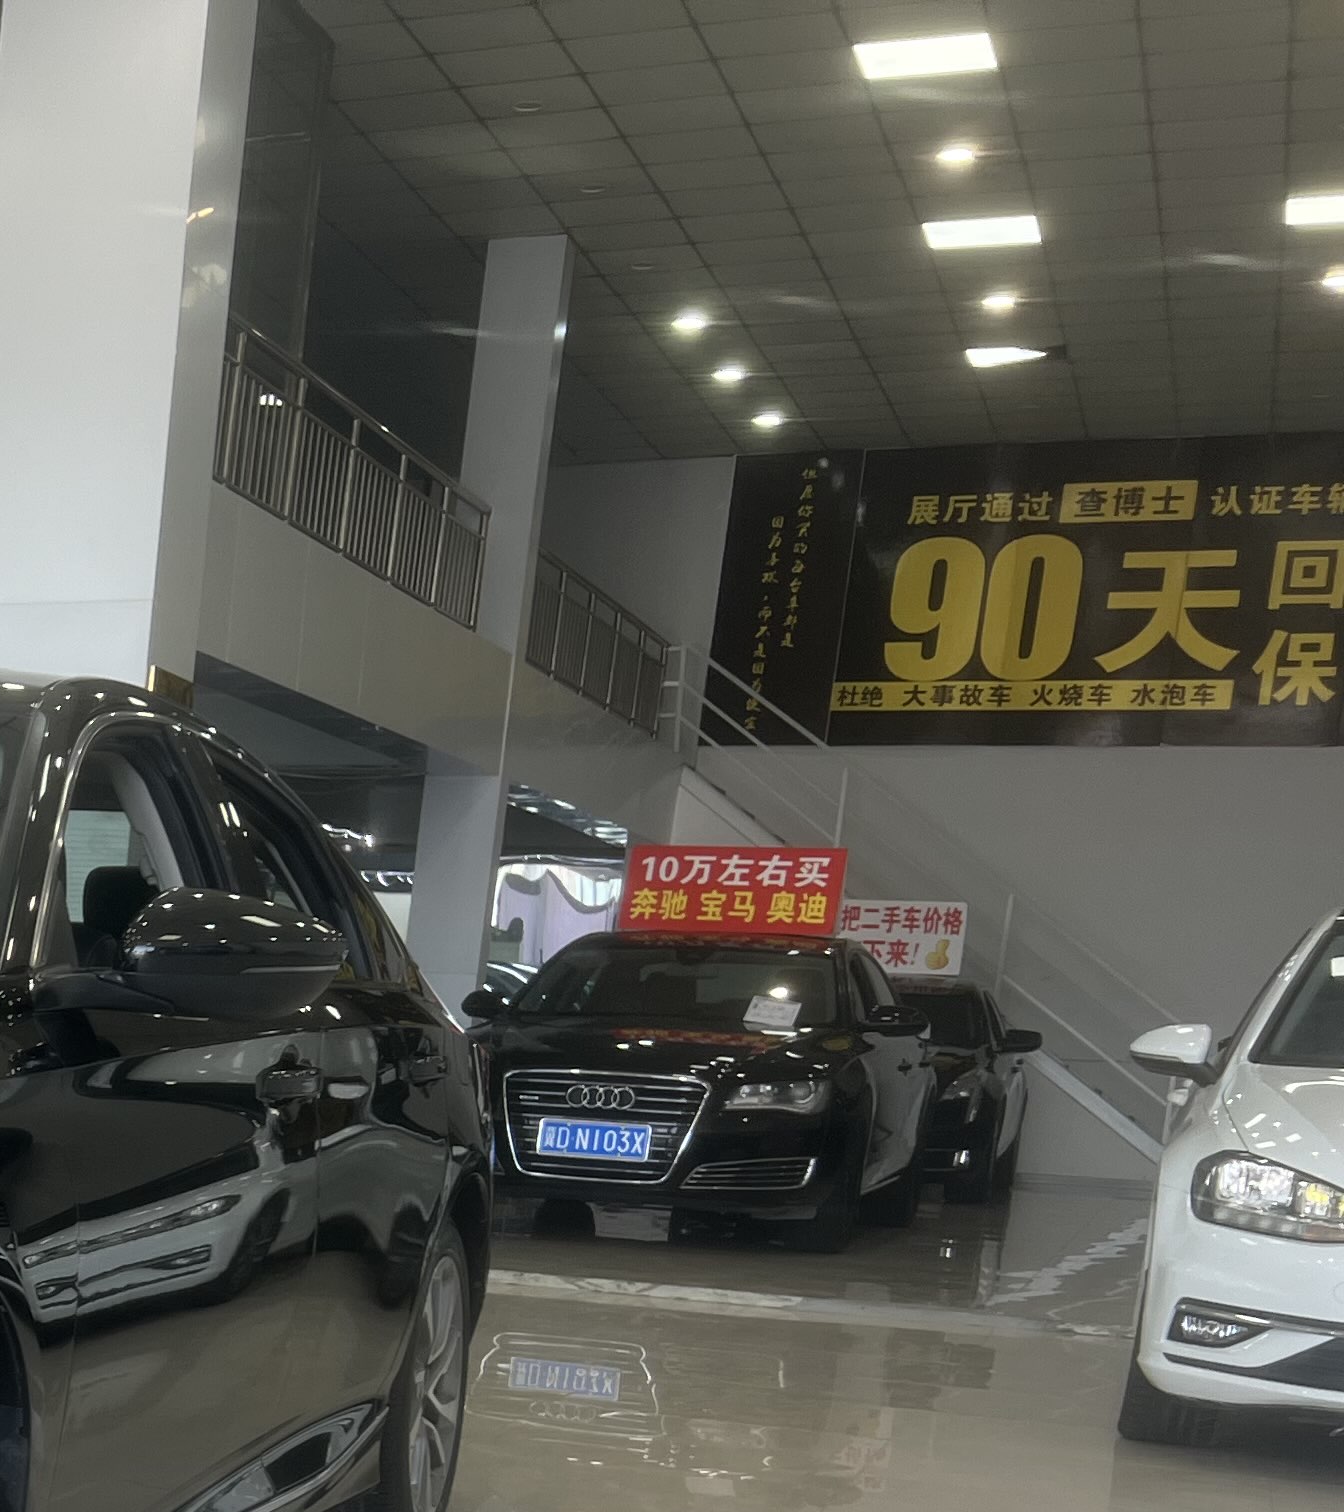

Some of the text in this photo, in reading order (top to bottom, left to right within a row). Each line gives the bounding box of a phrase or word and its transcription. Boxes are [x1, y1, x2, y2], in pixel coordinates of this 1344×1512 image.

[907, 491, 1052, 525] 展厅通过
[1073, 486, 1185, 518] 查博士
[1252, 629, 1337, 706] 保
[837, 683, 1217, 708] 杜绝 大事故车 火烧车 水泡车
[641, 854, 832, 888] 10万左右买
[629, 888, 827, 925] 奔驰 宝马 奥迪
[841, 904, 963, 935] 把二手车价格
[859, 939, 920, 967] 下来!
